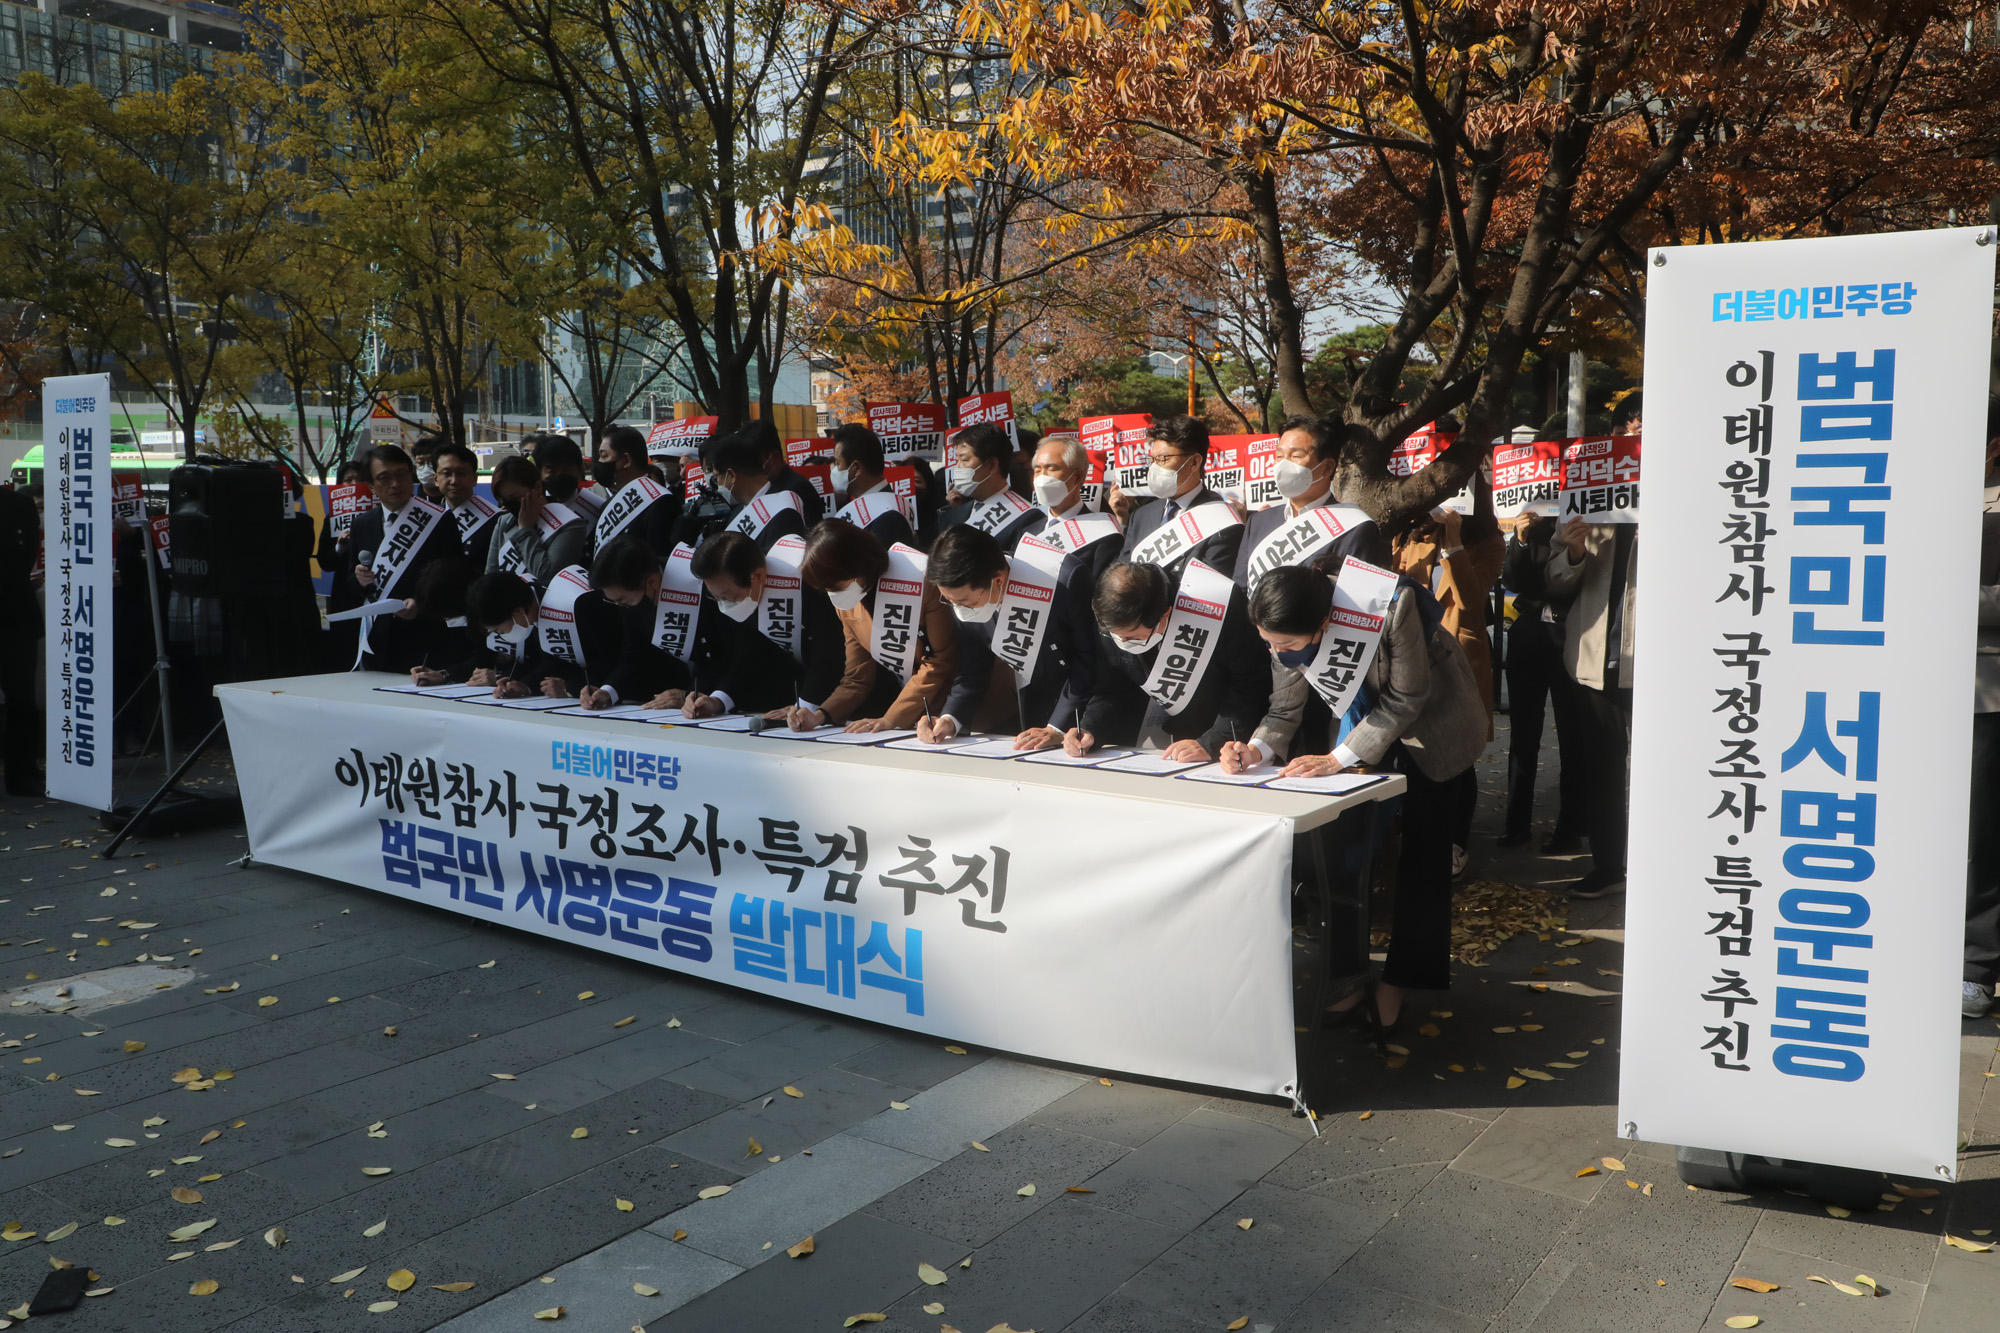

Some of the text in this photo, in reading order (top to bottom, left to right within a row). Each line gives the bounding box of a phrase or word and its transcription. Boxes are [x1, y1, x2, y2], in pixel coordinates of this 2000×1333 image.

[1712, 281, 1917, 322] 더불어민주당
[55, 396, 97, 414] 더불어민주당
[872, 406, 898, 416] 참사책임
[650, 423, 710, 442] 국정조사로
[871, 414, 934, 436] 한덕수는
[1084, 419, 1111, 432] 이태원참사
[1499, 447, 1532, 463] 이태원참사
[1568, 441, 1608, 458] 참사책임
[59, 426, 72, 551] 이태원참사
[1714, 349, 1778, 617] 이태원참사
[174, 556, 209, 576] MIPRO
[73, 427, 95, 768] 범국민 서명운동
[661, 592, 699, 604] 이태원참사
[880, 581, 920, 595] 이태원참사
[1008, 583, 1051, 600] 이태원참사
[1177, 597, 1224, 619] 이태원참사
[1331, 609, 1382, 631] 이태원참사
[1150, 624, 1210, 702] 책임자
[1770, 348, 1896, 1083] 범국민 서명운동
[61, 715, 73, 764] 추진
[551, 740, 682, 791] 더불어민주당
[878, 834, 1012, 934] 추진
[377, 817, 926, 1017] 범국민 서명운동 발대식
[1700, 968, 1759, 1073] 추진
